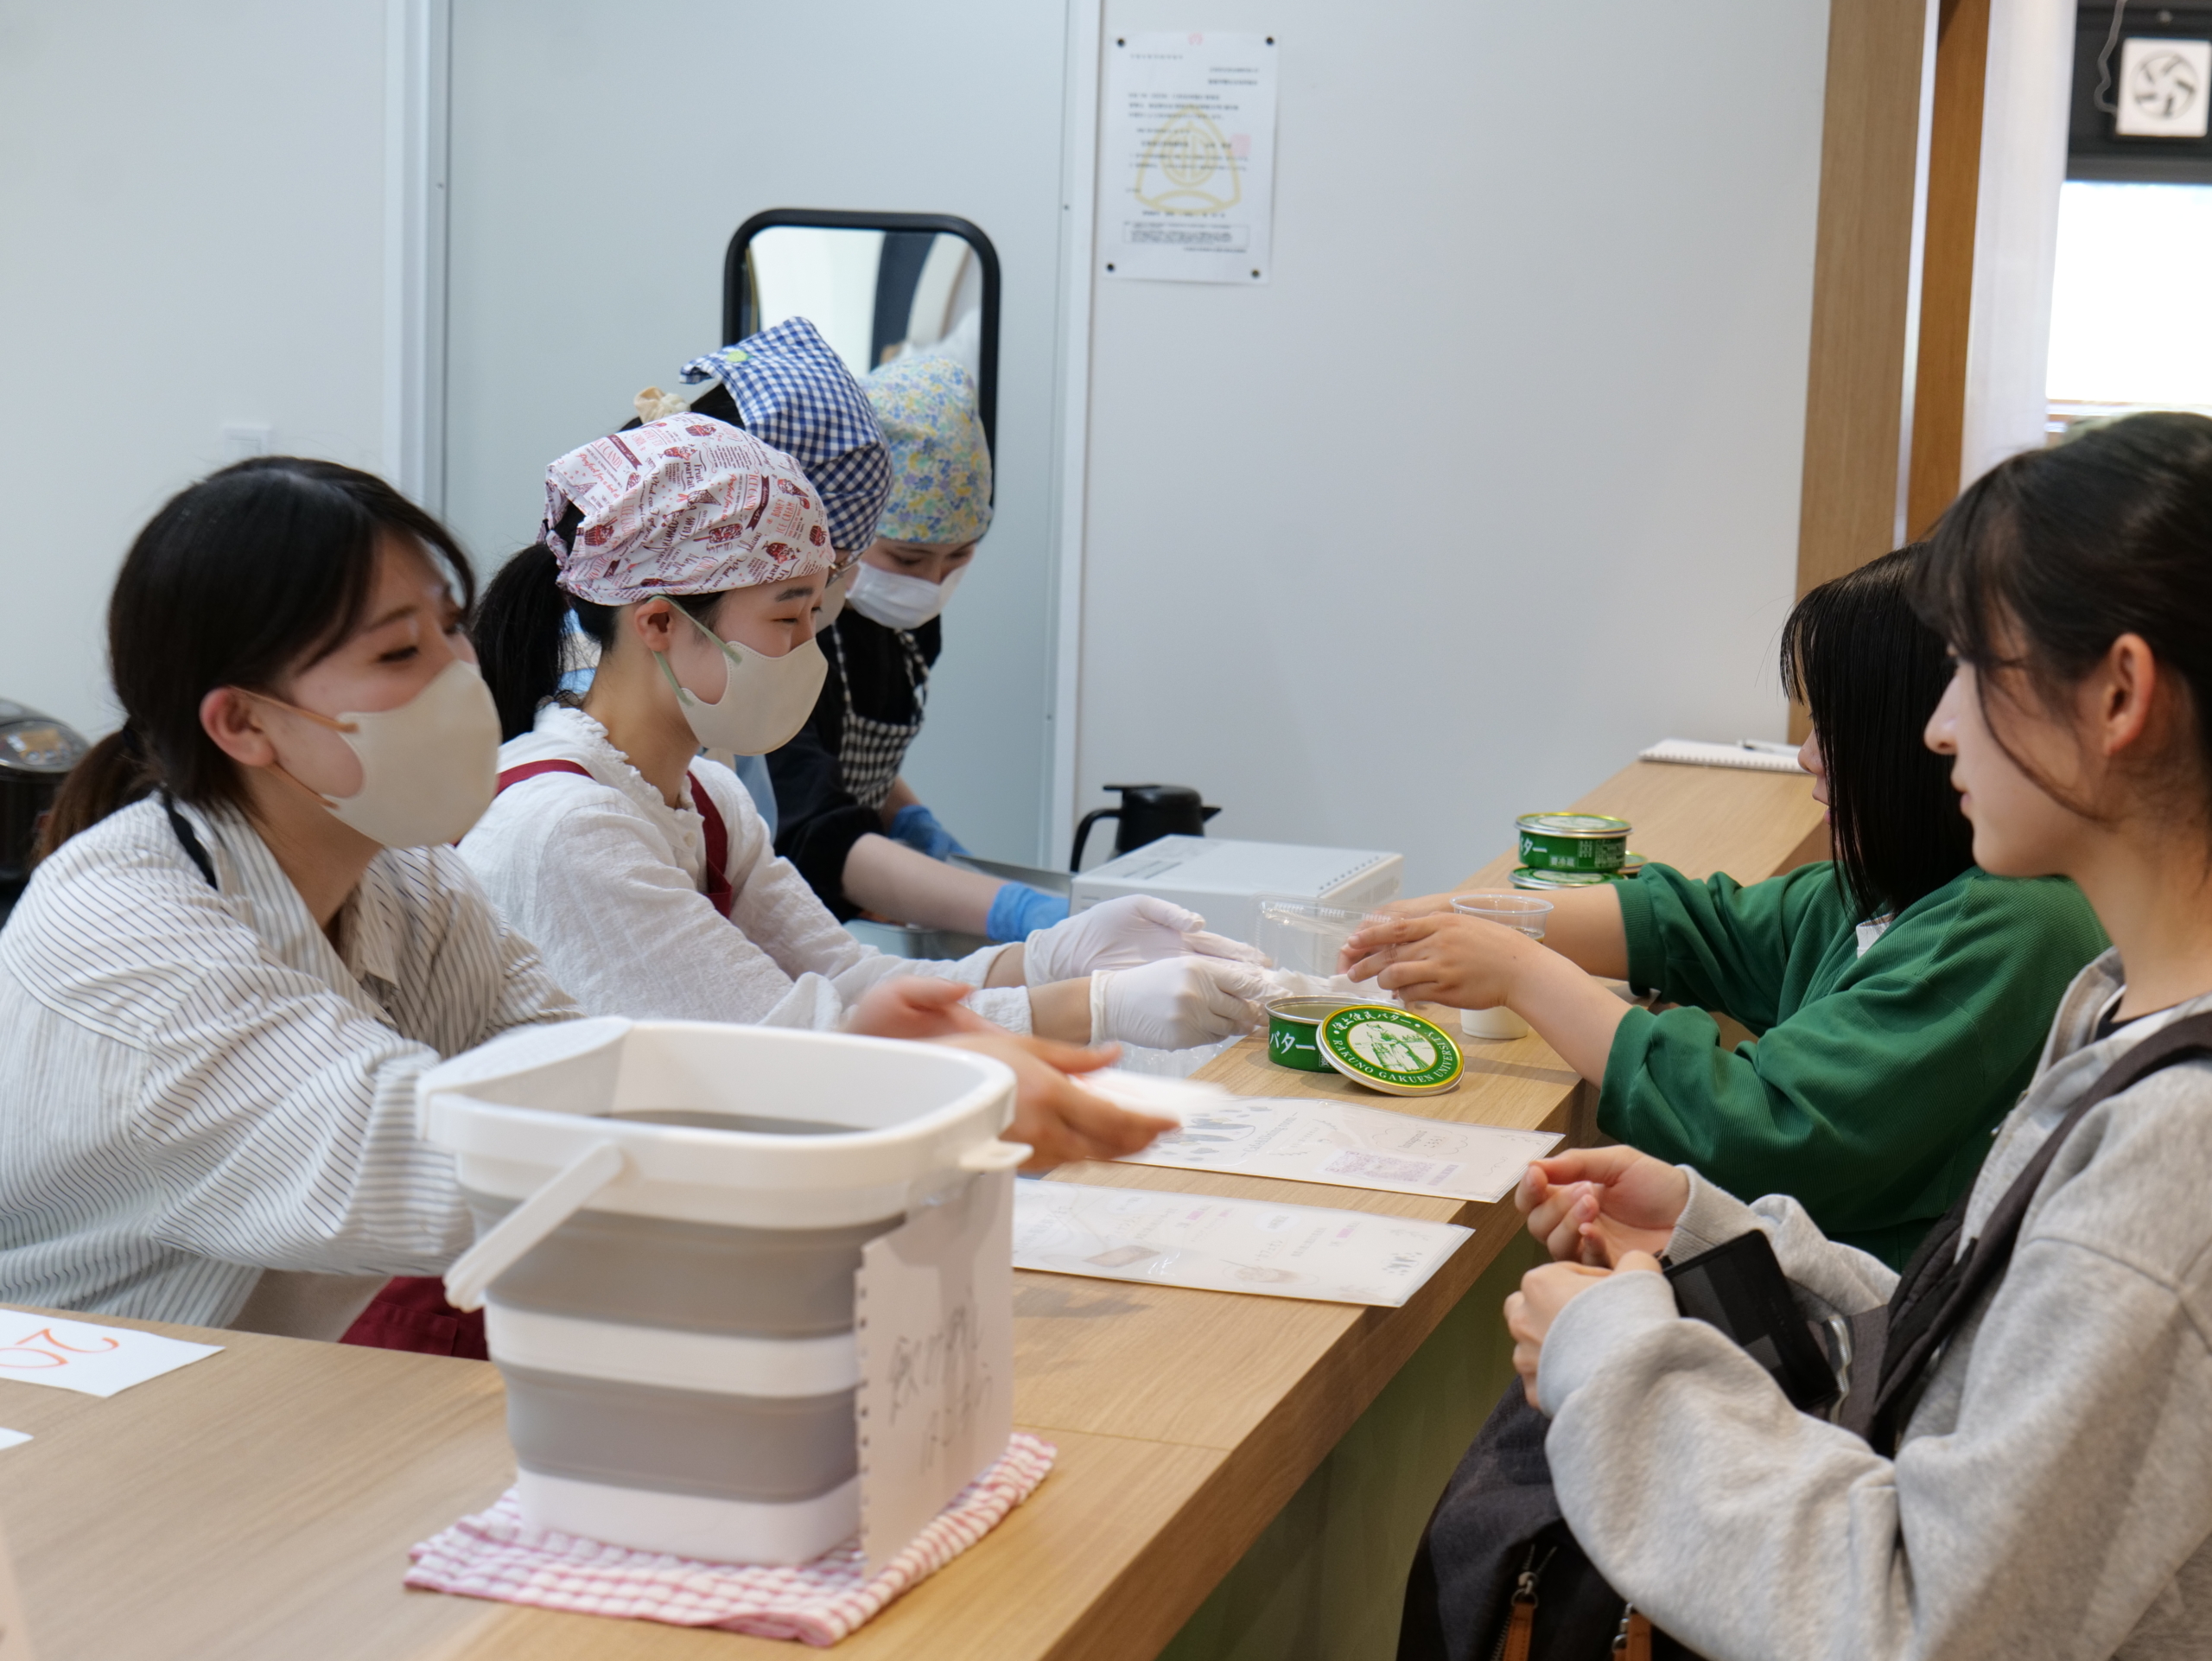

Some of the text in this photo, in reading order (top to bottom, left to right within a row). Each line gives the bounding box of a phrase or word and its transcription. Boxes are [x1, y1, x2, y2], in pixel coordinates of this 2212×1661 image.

[575, 453, 601, 473] Perfect
[593, 473, 605, 482] for
[603, 445, 623, 469] CANDY
[649, 468, 660, 495] What
[683, 461, 695, 490] parfait
[694, 463, 704, 484] Fruit
[728, 474, 736, 500] Perfect
[744, 474, 759, 511] ICE CANDY
[646, 518, 657, 528] get
[776, 501, 796, 534] ICE CREAM
[712, 556, 747, 589] What can
[1332, 1039, 1435, 1084] RAKUNO GAKUEN
[1424, 1030, 1453, 1078] UNIVERSITY
